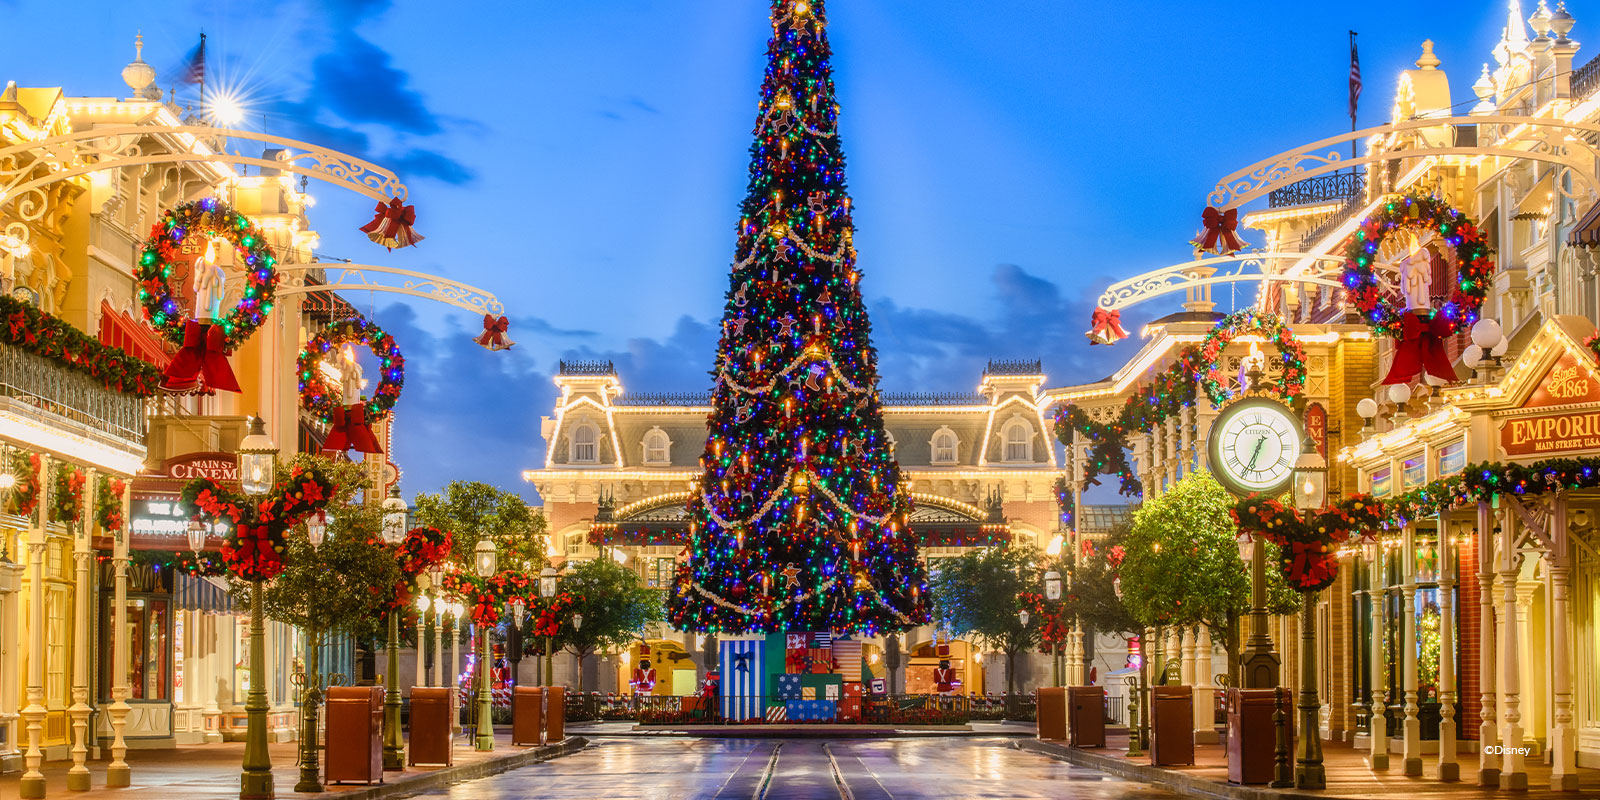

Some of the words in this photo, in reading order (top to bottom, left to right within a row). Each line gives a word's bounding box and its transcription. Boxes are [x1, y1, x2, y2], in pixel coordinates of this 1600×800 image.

[1549, 366, 1578, 386] Since
[1561, 380, 1589, 398] 1863
[1511, 414, 1600, 445] EMPORIU
[1535, 441, 1554, 451] MAIN
[171, 464, 239, 480] CINEM
[192, 460, 219, 469] MAIN
